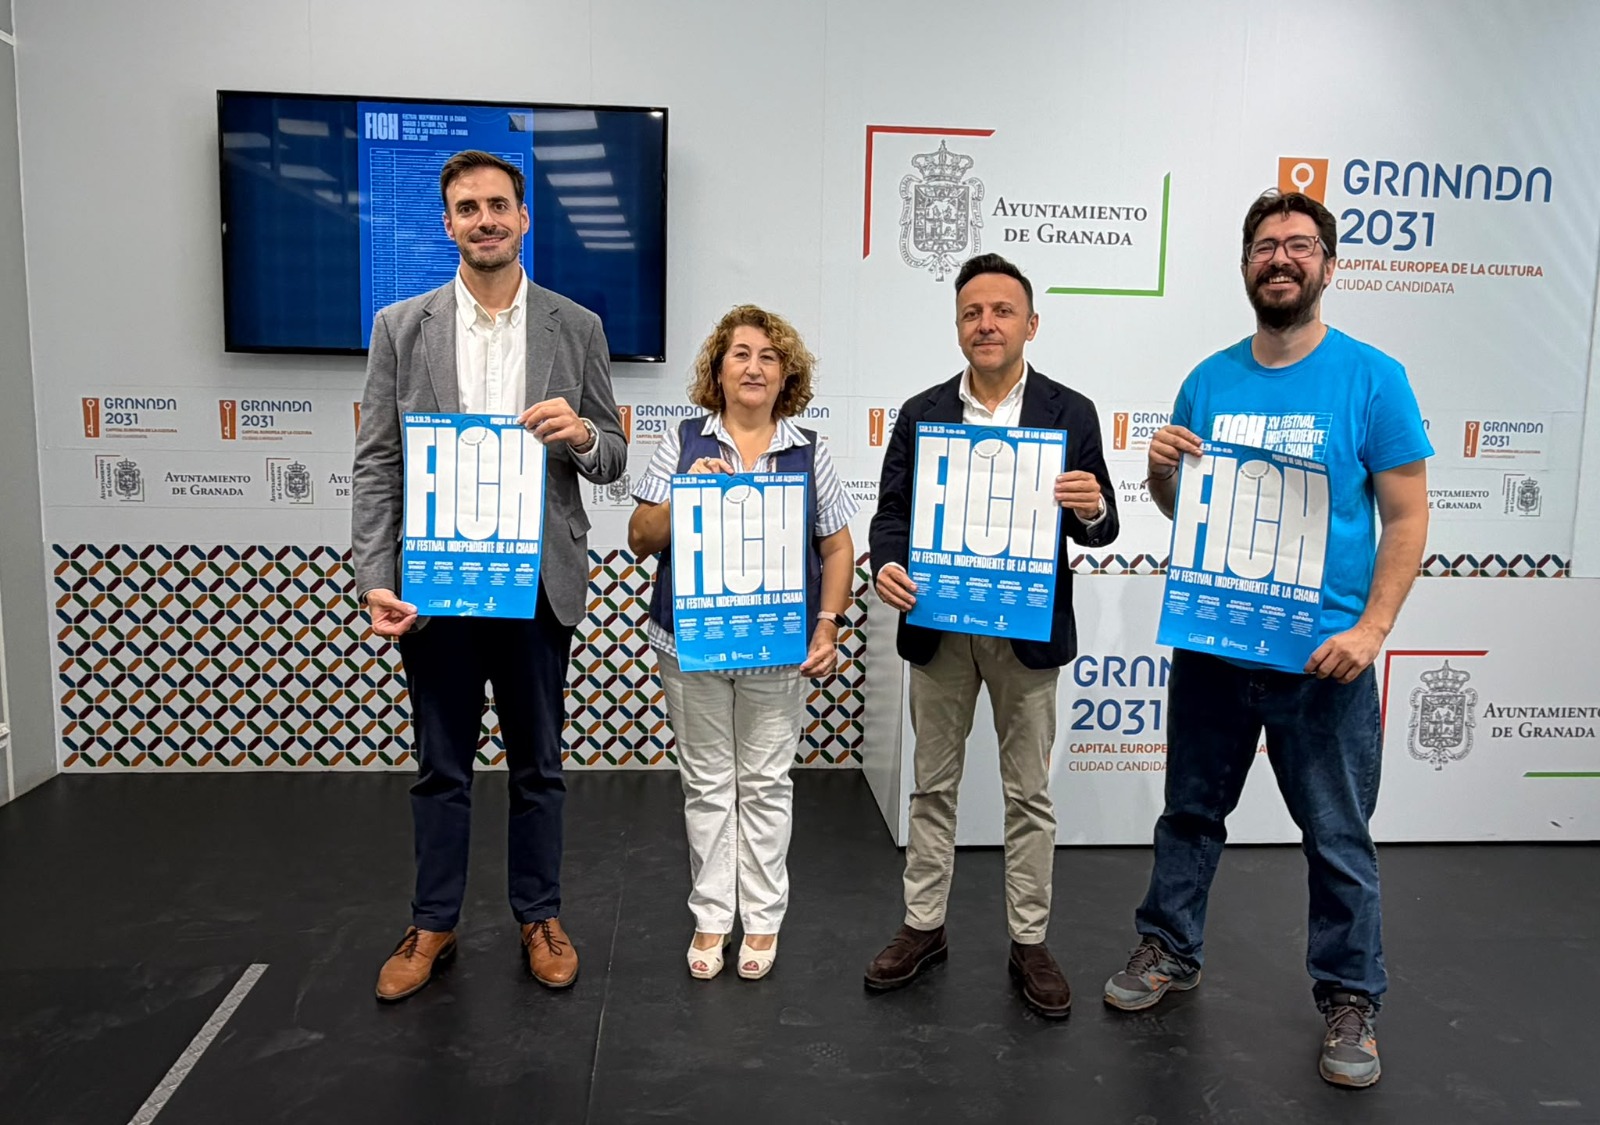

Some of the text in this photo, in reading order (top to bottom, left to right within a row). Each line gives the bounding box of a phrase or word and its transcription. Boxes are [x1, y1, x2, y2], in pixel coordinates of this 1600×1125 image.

[365, 112, 398, 140] FICH
[1343, 158, 1552, 203] GRANADA
[991, 196, 1148, 221] AYUNTAMIENTO
[1003, 222, 1133, 246] DE GRANADA
[1339, 208, 1435, 251] 2031
[1336, 259, 1544, 277] CAPITAL EUROPEA DE LA CULTURA
[1335, 278, 1455, 294] CIUDAD CANDIDATA
[104, 397, 177, 410] GRANADA
[241, 400, 312, 412] GRANADA
[636, 405, 703, 417] GRANADA
[1132, 412, 1173, 424] GRAN
[105, 412, 138, 426] 2031
[241, 415, 274, 428] 2031
[1267, 414, 1316, 429] XV FESTIVAL
[636, 420, 667, 433] 2031
[1132, 427, 1160, 439] 203
[1212, 414, 1268, 448] FICH
[1483, 421, 1544, 434] GRANADA
[1264, 430, 1326, 444] INDEPENDIENTE
[1482, 435, 1510, 448] 2031
[1285, 444, 1314, 458] CHANA
[164, 472, 250, 484] AYUNTAMIENTO
[406, 426, 544, 541] FICH
[172, 484, 244, 496] DE GRANADA
[336, 488, 350, 496] DE
[1426, 490, 1490, 498] YUNTAMIENTO
[912, 436, 1063, 560] FICH
[1437, 499, 1482, 509] GRANADA
[1171, 452, 1329, 589] FICH
[406, 540, 538, 554] XV FESTIVAL INDEPENDIENTE DE LA CHANA
[672, 484, 804, 596] FICH
[911, 551, 1053, 575] XV FESTIVAL INDEPENDIENTE DE LA CHANA
[1169, 568, 1319, 604] XV FESTIVAL INDEPENDIENTE DE LA CHANA
[676, 592, 803, 610] XV FESTIVAL INDEPENDIENTE DE LA CHANA
[1073, 655, 1172, 687] GRAN
[1070, 698, 1161, 735] 2031
[1492, 722, 1596, 739] DE GRANADA
[1070, 743, 1168, 754] CAPITAL EUROPE
[1068, 761, 1167, 772] CIUDAD CANDIDA
